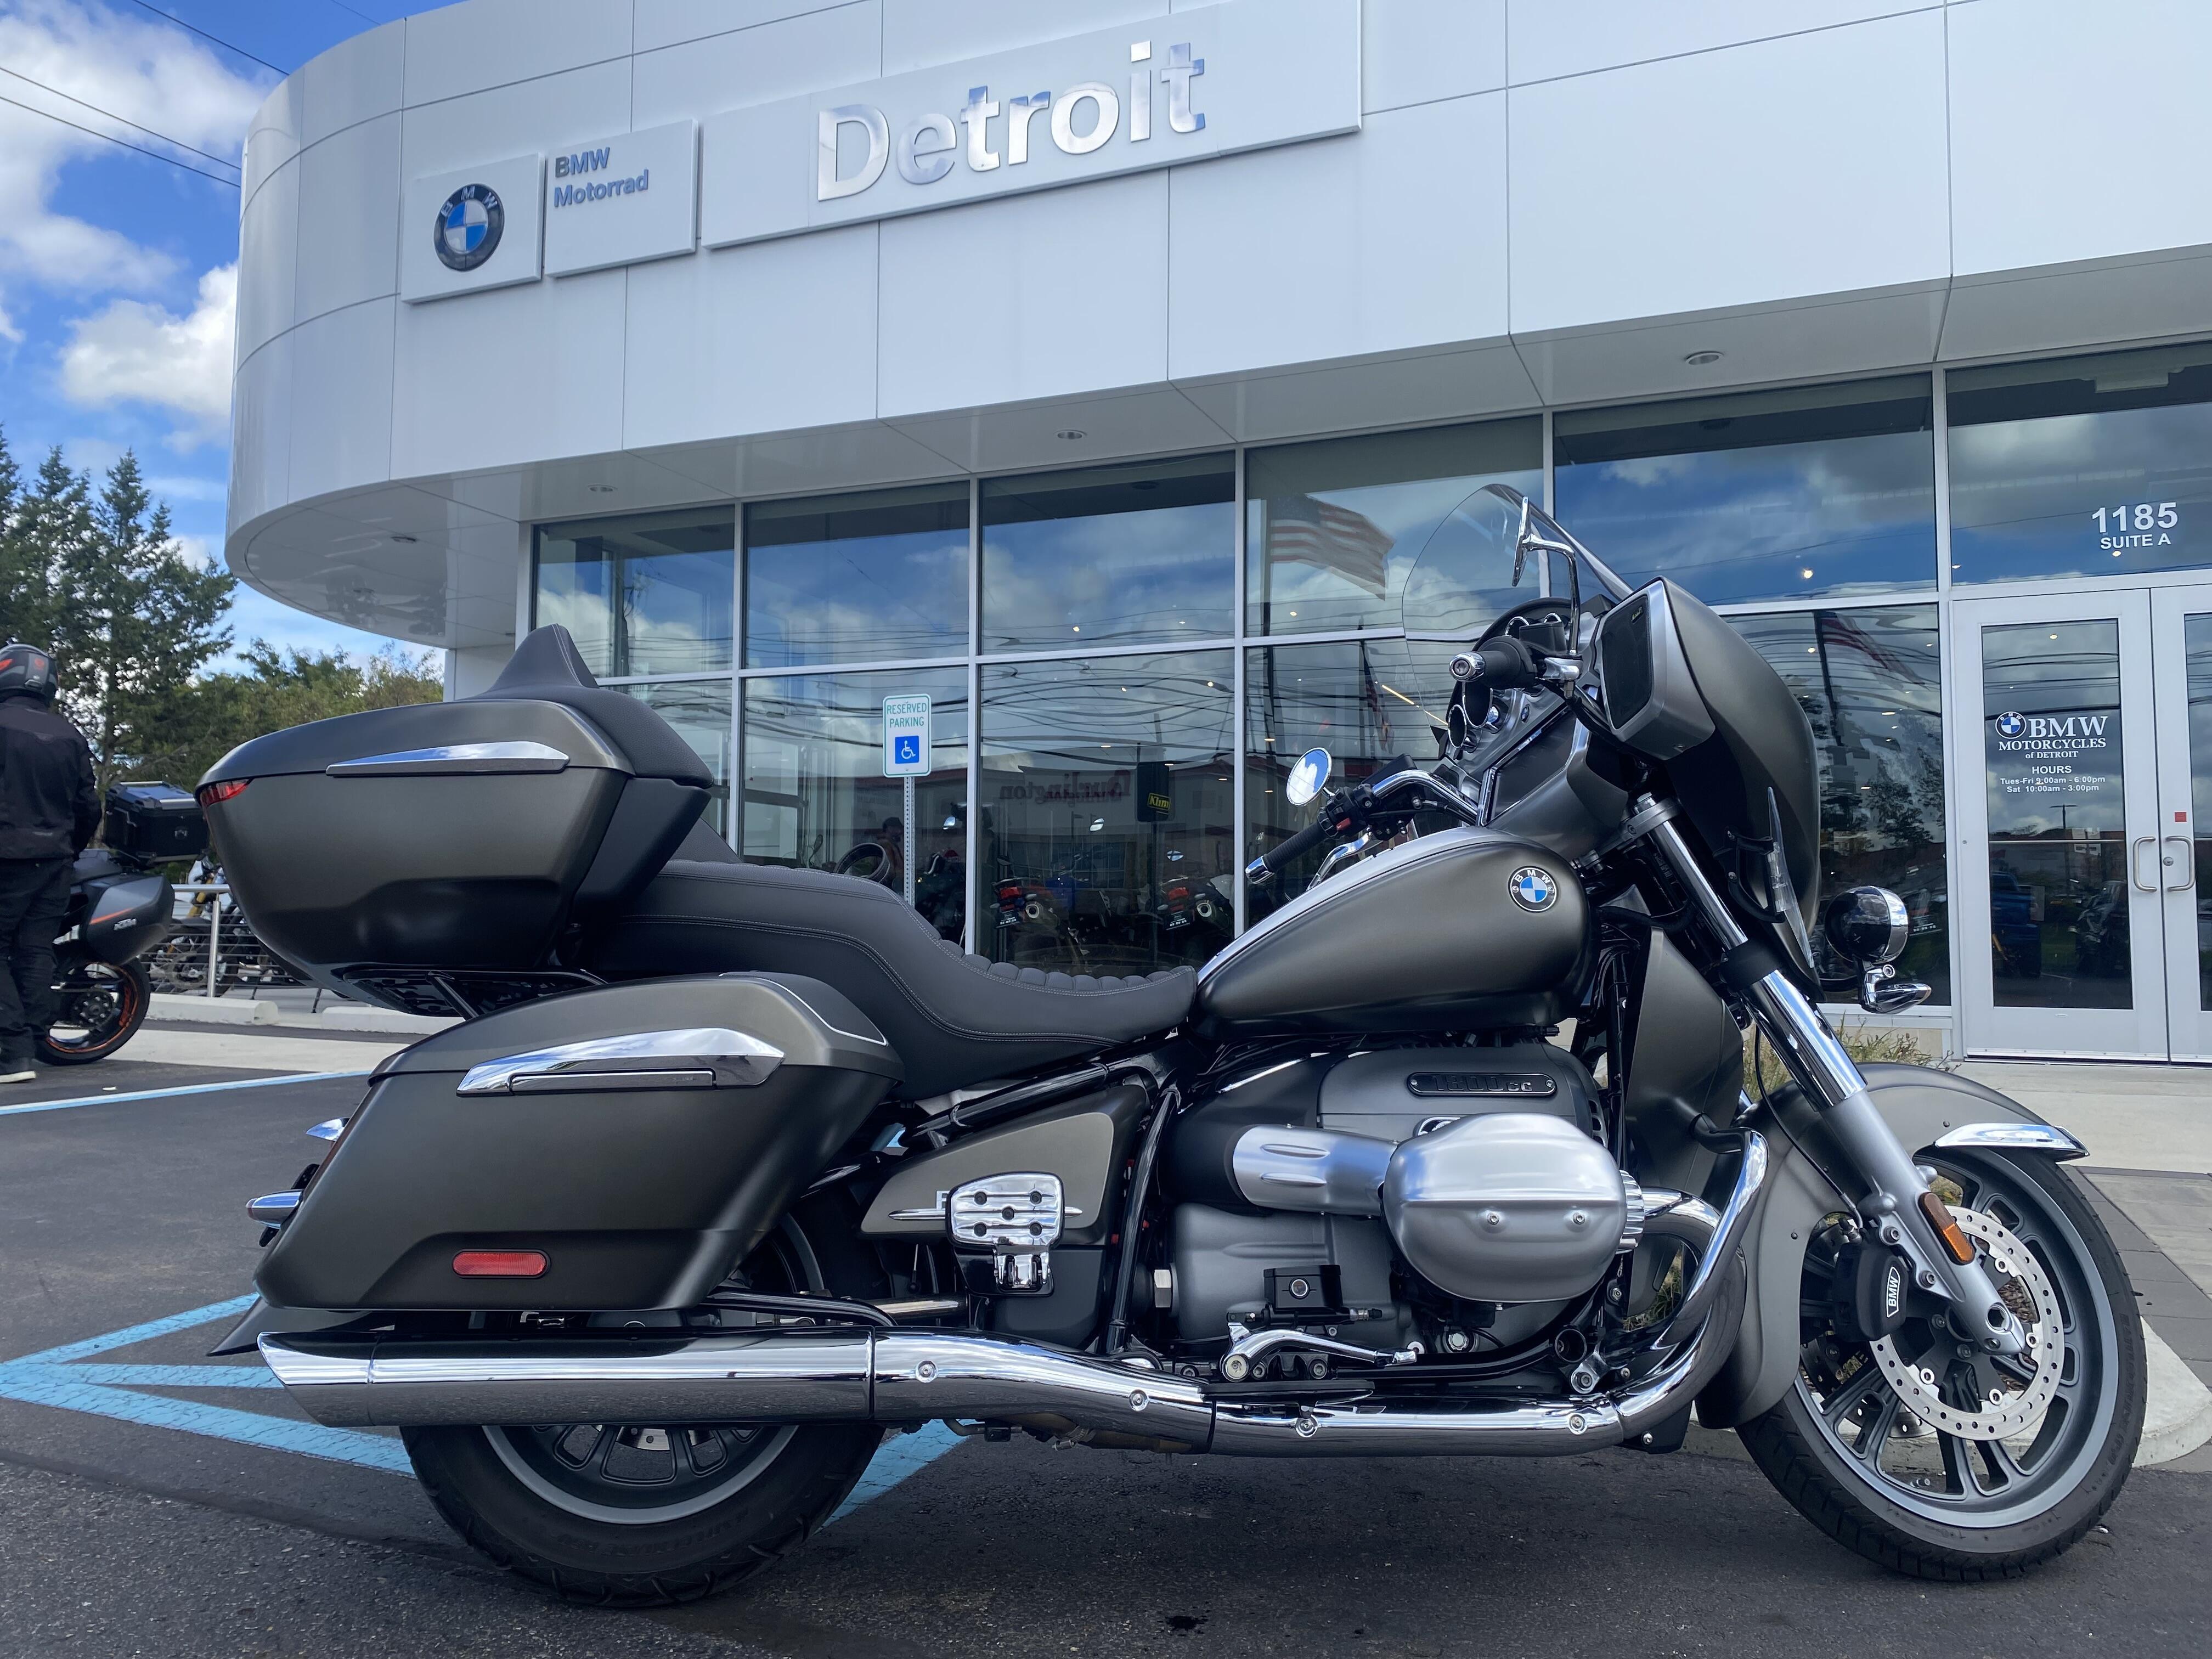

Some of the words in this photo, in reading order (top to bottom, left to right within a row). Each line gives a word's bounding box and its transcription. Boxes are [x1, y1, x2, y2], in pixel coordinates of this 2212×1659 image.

[817, 41, 1206, 202] Detroit
[555, 147, 610, 178] BMW
[554, 170, 649, 207] Motorrad
[441, 187, 498, 218] BMW
[2092, 502, 2178, 533] 1185
[2101, 534, 2153, 549] SUITE
[2158, 533, 2171, 545] A
[887, 703, 927, 714] RESERVED
[890, 716, 924, 728] PARKING
[2028, 716, 2108, 738] BMW
[1999, 738, 2106, 751] MOTORCYCLES
[2032, 765, 2072, 774] HOURS
[2068, 785, 2099, 793] 3:00pm
[2074, 776, 2106, 785] 6:00pm
[1888, 1276, 1899, 1307] BMW
